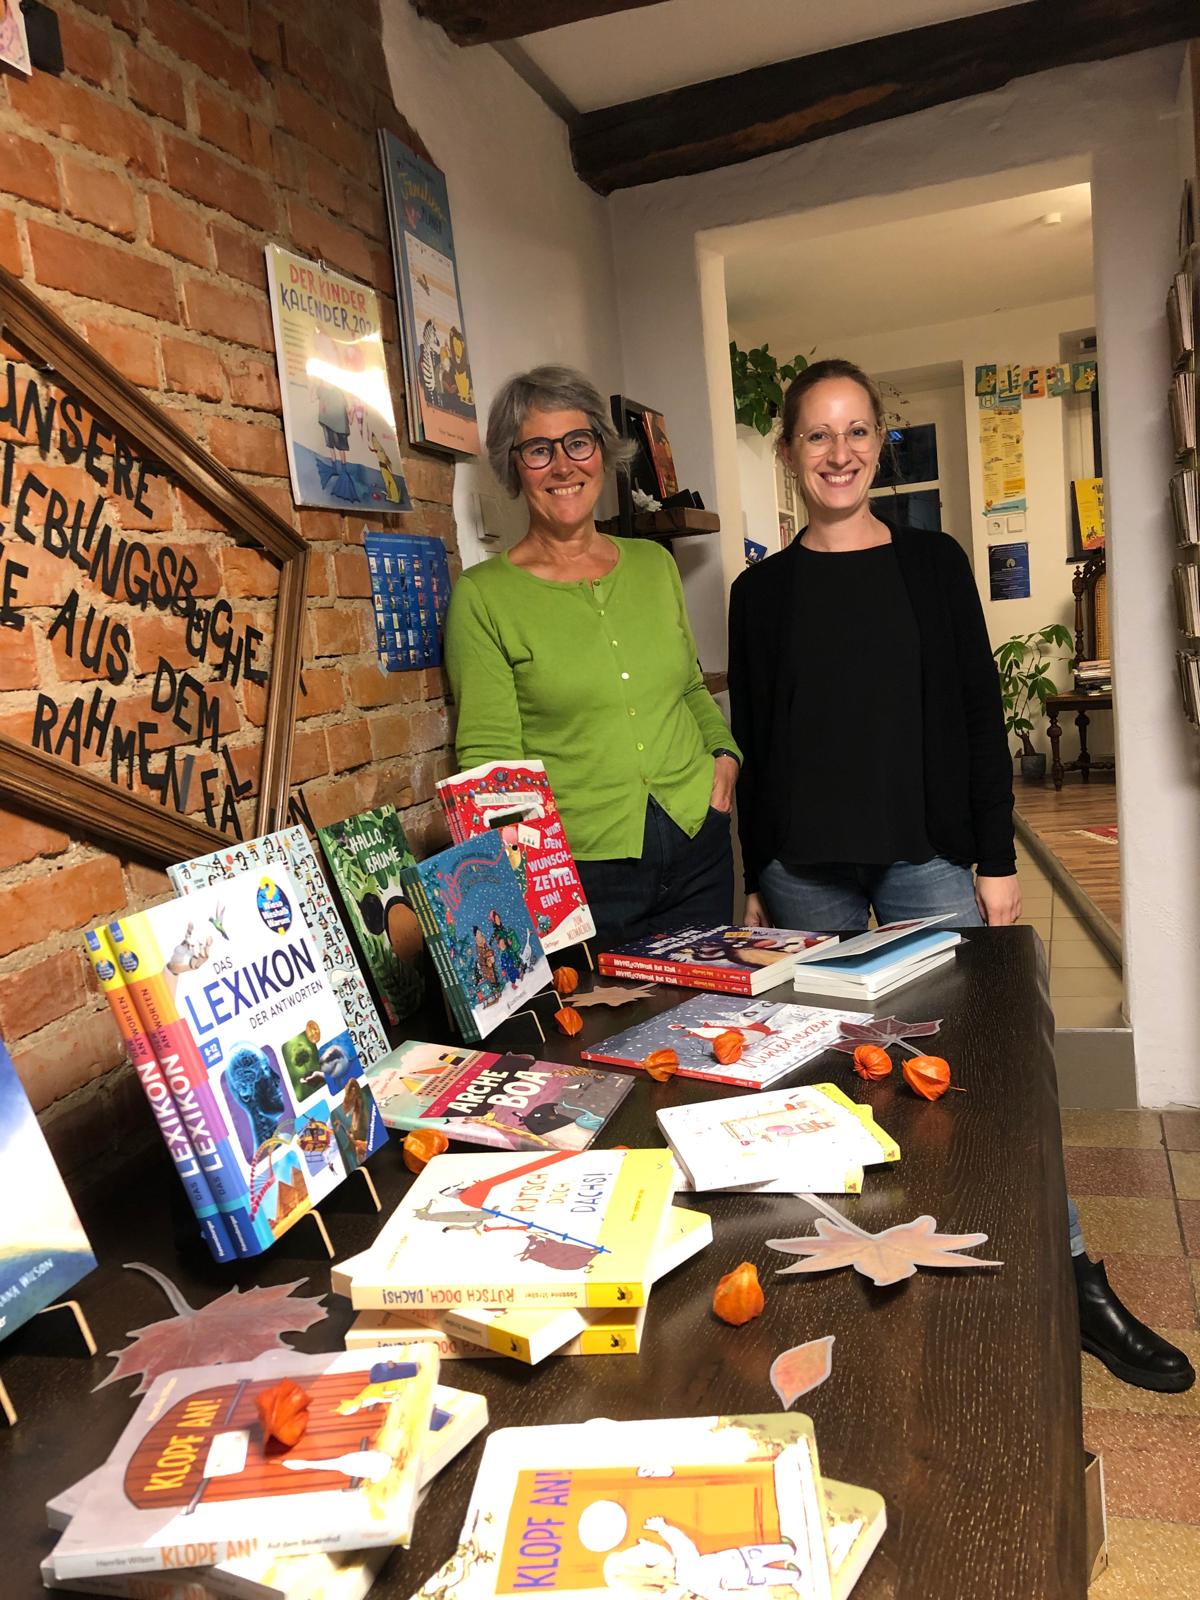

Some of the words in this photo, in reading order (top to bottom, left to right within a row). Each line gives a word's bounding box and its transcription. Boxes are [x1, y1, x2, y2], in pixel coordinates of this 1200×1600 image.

[280, 283, 351, 331] KALENDER
[318, 275, 367, 315] KINDER
[46, 588, 131, 686] AUS
[152, 656, 220, 753] DEM
[31, 687, 195, 812] RAHMEN
[349, 828, 385, 854] HALLO,
[365, 846, 401, 874] BÄUME
[543, 837, 562, 850] DEN
[528, 853, 572, 873] WUNSCH-
[533, 868, 577, 892] ZETTEL
[540, 890, 562, 909] EIN!
[213, 956, 233, 975] DAS
[184, 937, 317, 1036] LEXIKON
[249, 1010, 270, 1029] DER
[270, 979, 325, 1022] ANTWORTEN
[118, 995, 148, 1057] ANTWORTEN
[140, 987, 171, 1049] ANTWORTEN
[447, 1068, 510, 1114] ARCHE
[486, 1070, 554, 1109] BOA
[137, 1060, 201, 1178] LEXIKON
[160, 1053, 224, 1173] LEXIKON
[510, 1173, 549, 1212] RUTSCH
[570, 1173, 613, 1213] DACHS!
[382, 1288, 424, 1304] DACHS!
[467, 1288, 514, 1303] RUTSCH
[143, 1435, 205, 1492] KLOPF
[176, 1398, 224, 1428] AN!
[529, 1471, 573, 1507] AN!
[160, 1541, 217, 1568] KLOPF
[226, 1538, 259, 1561] AN!
[512, 1516, 565, 1589] KLOPF
